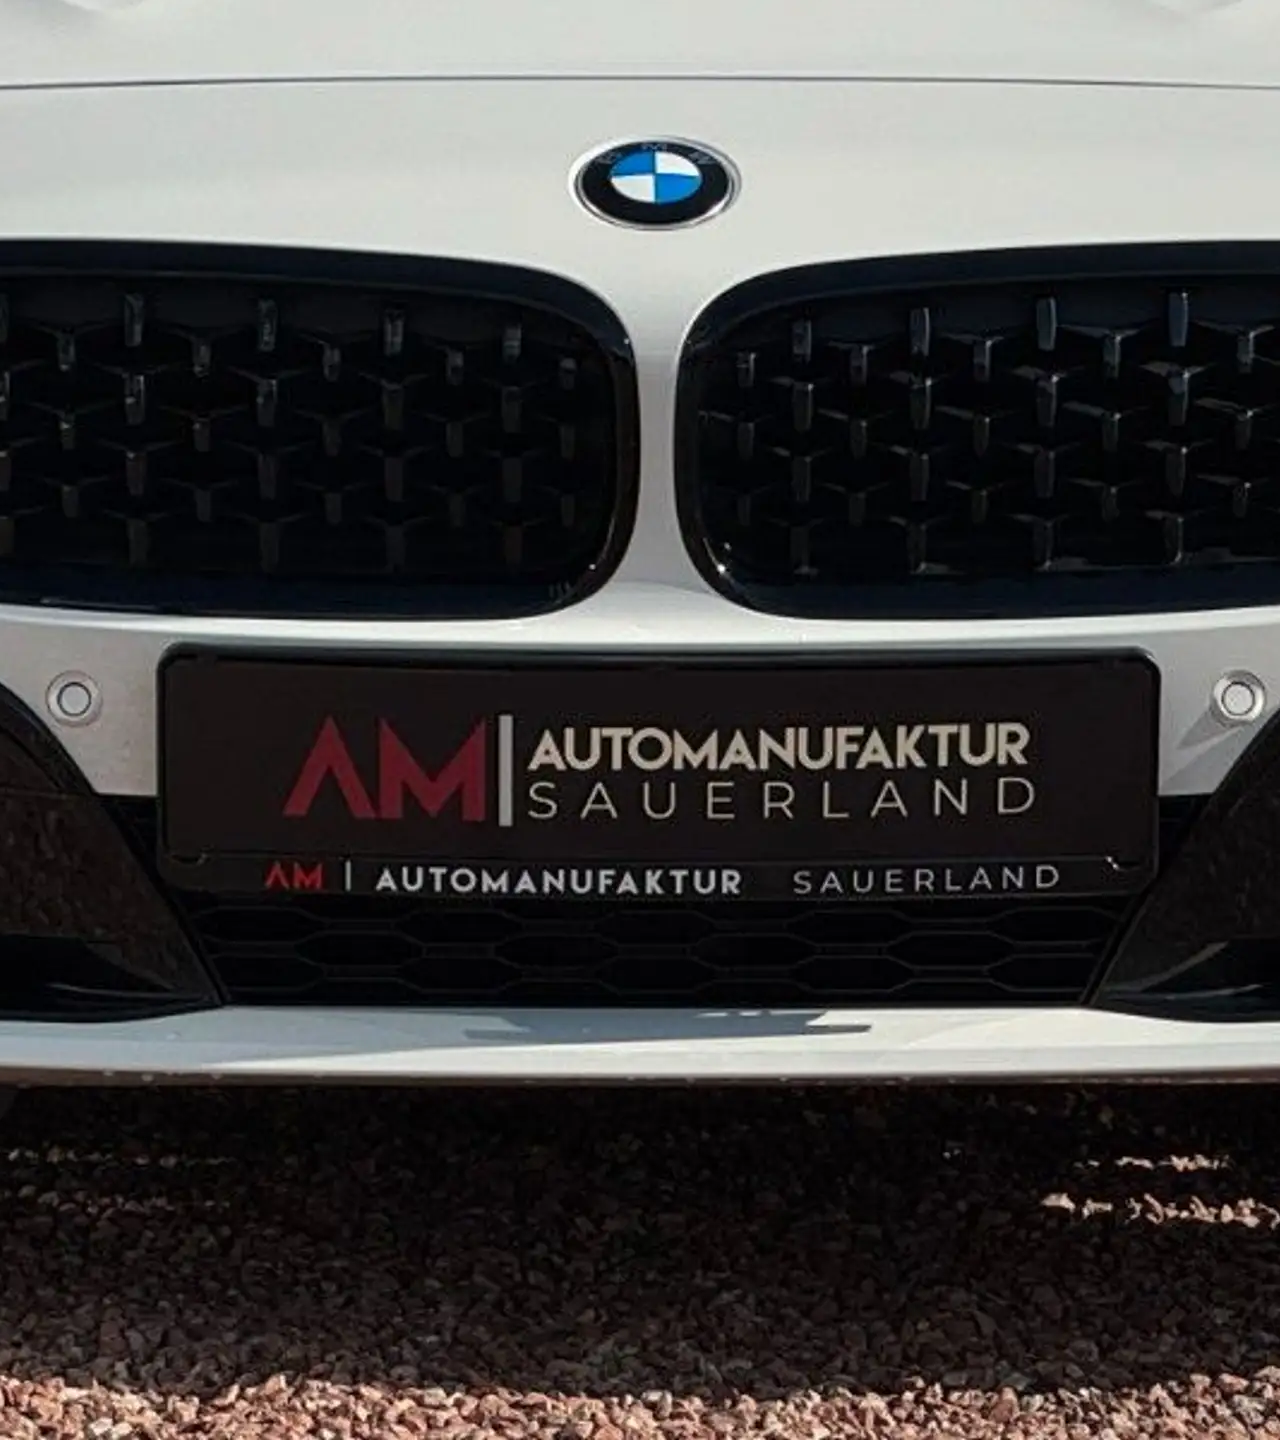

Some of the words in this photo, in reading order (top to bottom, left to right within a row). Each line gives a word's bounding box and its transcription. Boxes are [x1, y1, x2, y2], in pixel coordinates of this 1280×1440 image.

[284, 717, 486, 821] AM
[527, 722, 1030, 772] AUTOMANUFAKTUR
[528, 777, 1034, 820] SAUERLAND
[265, 861, 324, 889] AM
[375, 866, 741, 895] AUTOMANUFAKTUR
[793, 864, 1060, 894] SAUERLAND
